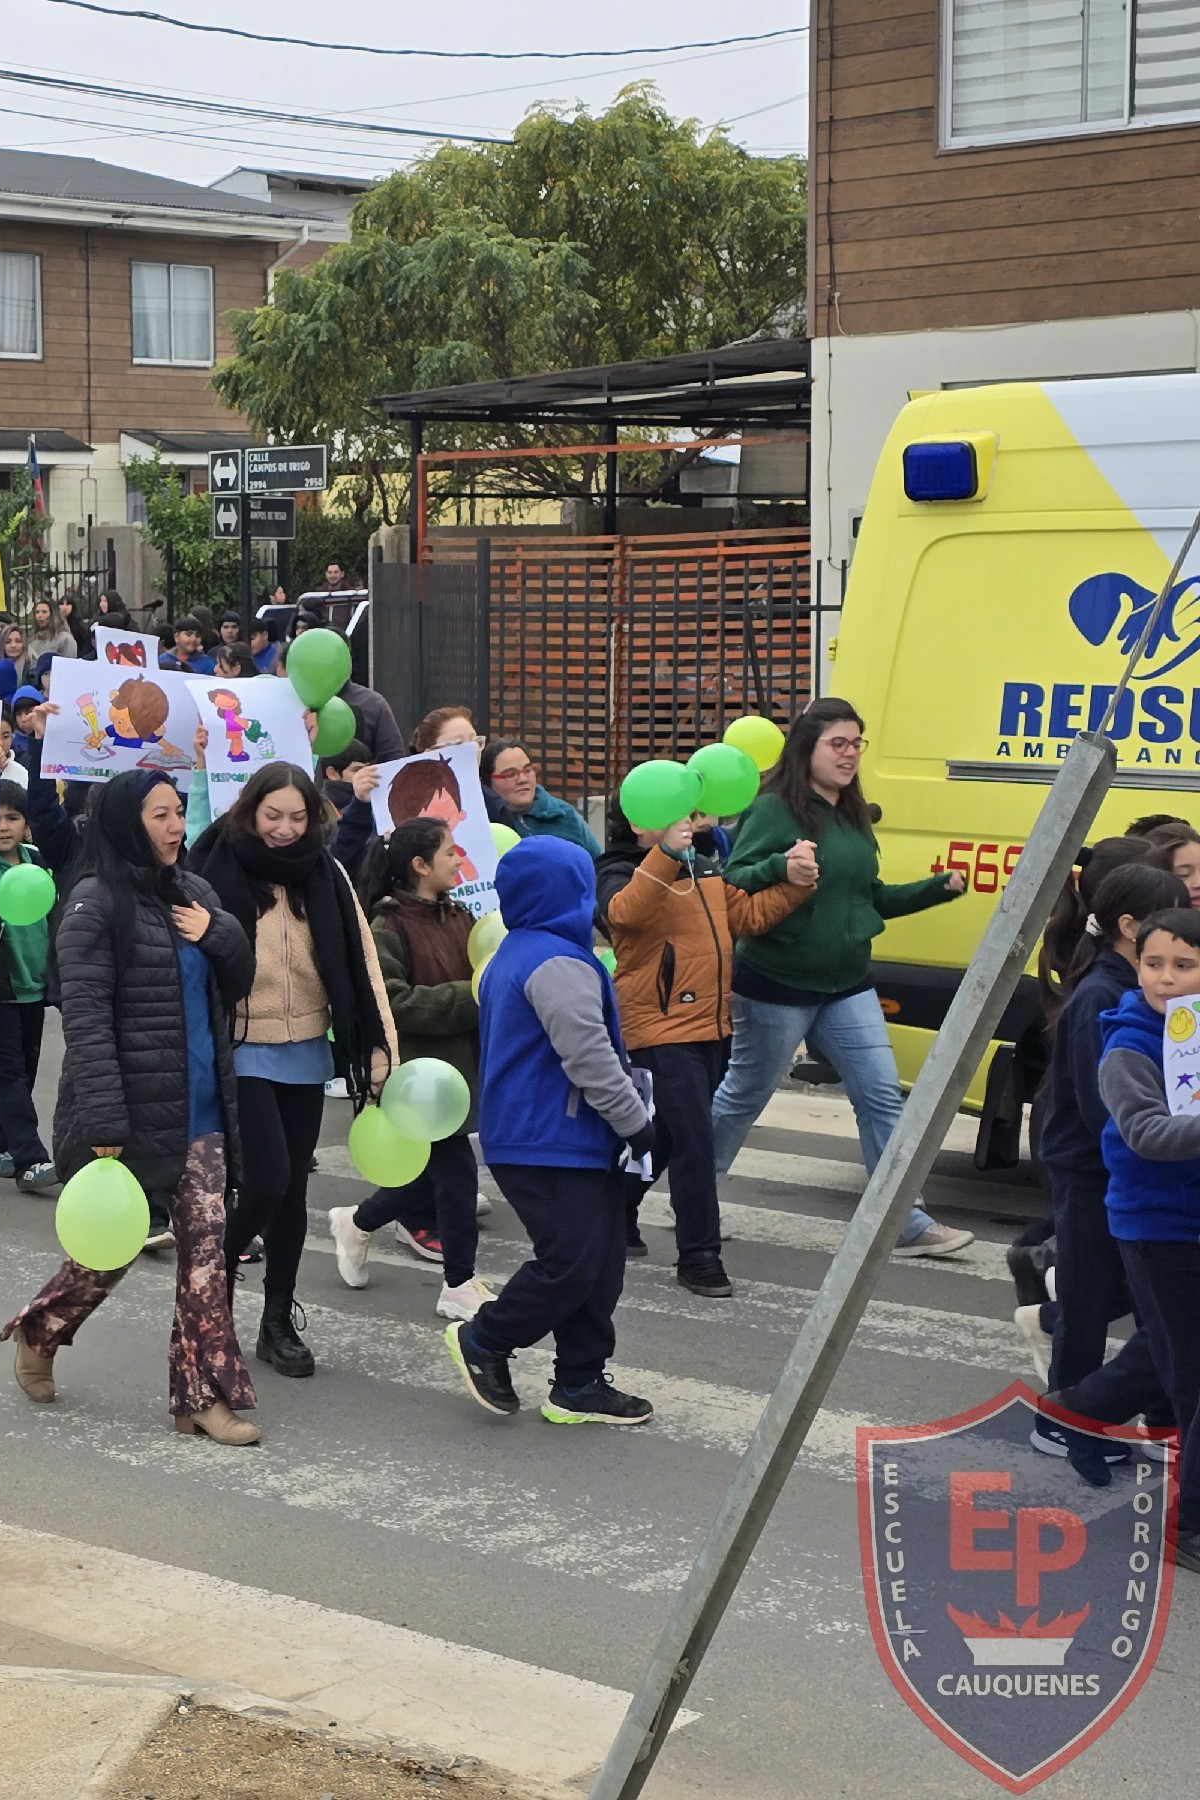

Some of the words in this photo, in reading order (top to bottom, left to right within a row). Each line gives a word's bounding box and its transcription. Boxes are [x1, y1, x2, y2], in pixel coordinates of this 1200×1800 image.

[249, 452, 269, 462] CALLE
[249, 463, 277, 473] CAMPOS
[278, 462, 288, 472] DE
[289, 461, 311, 471] TRIGO
[996, 741, 1200, 765] AMBAN
